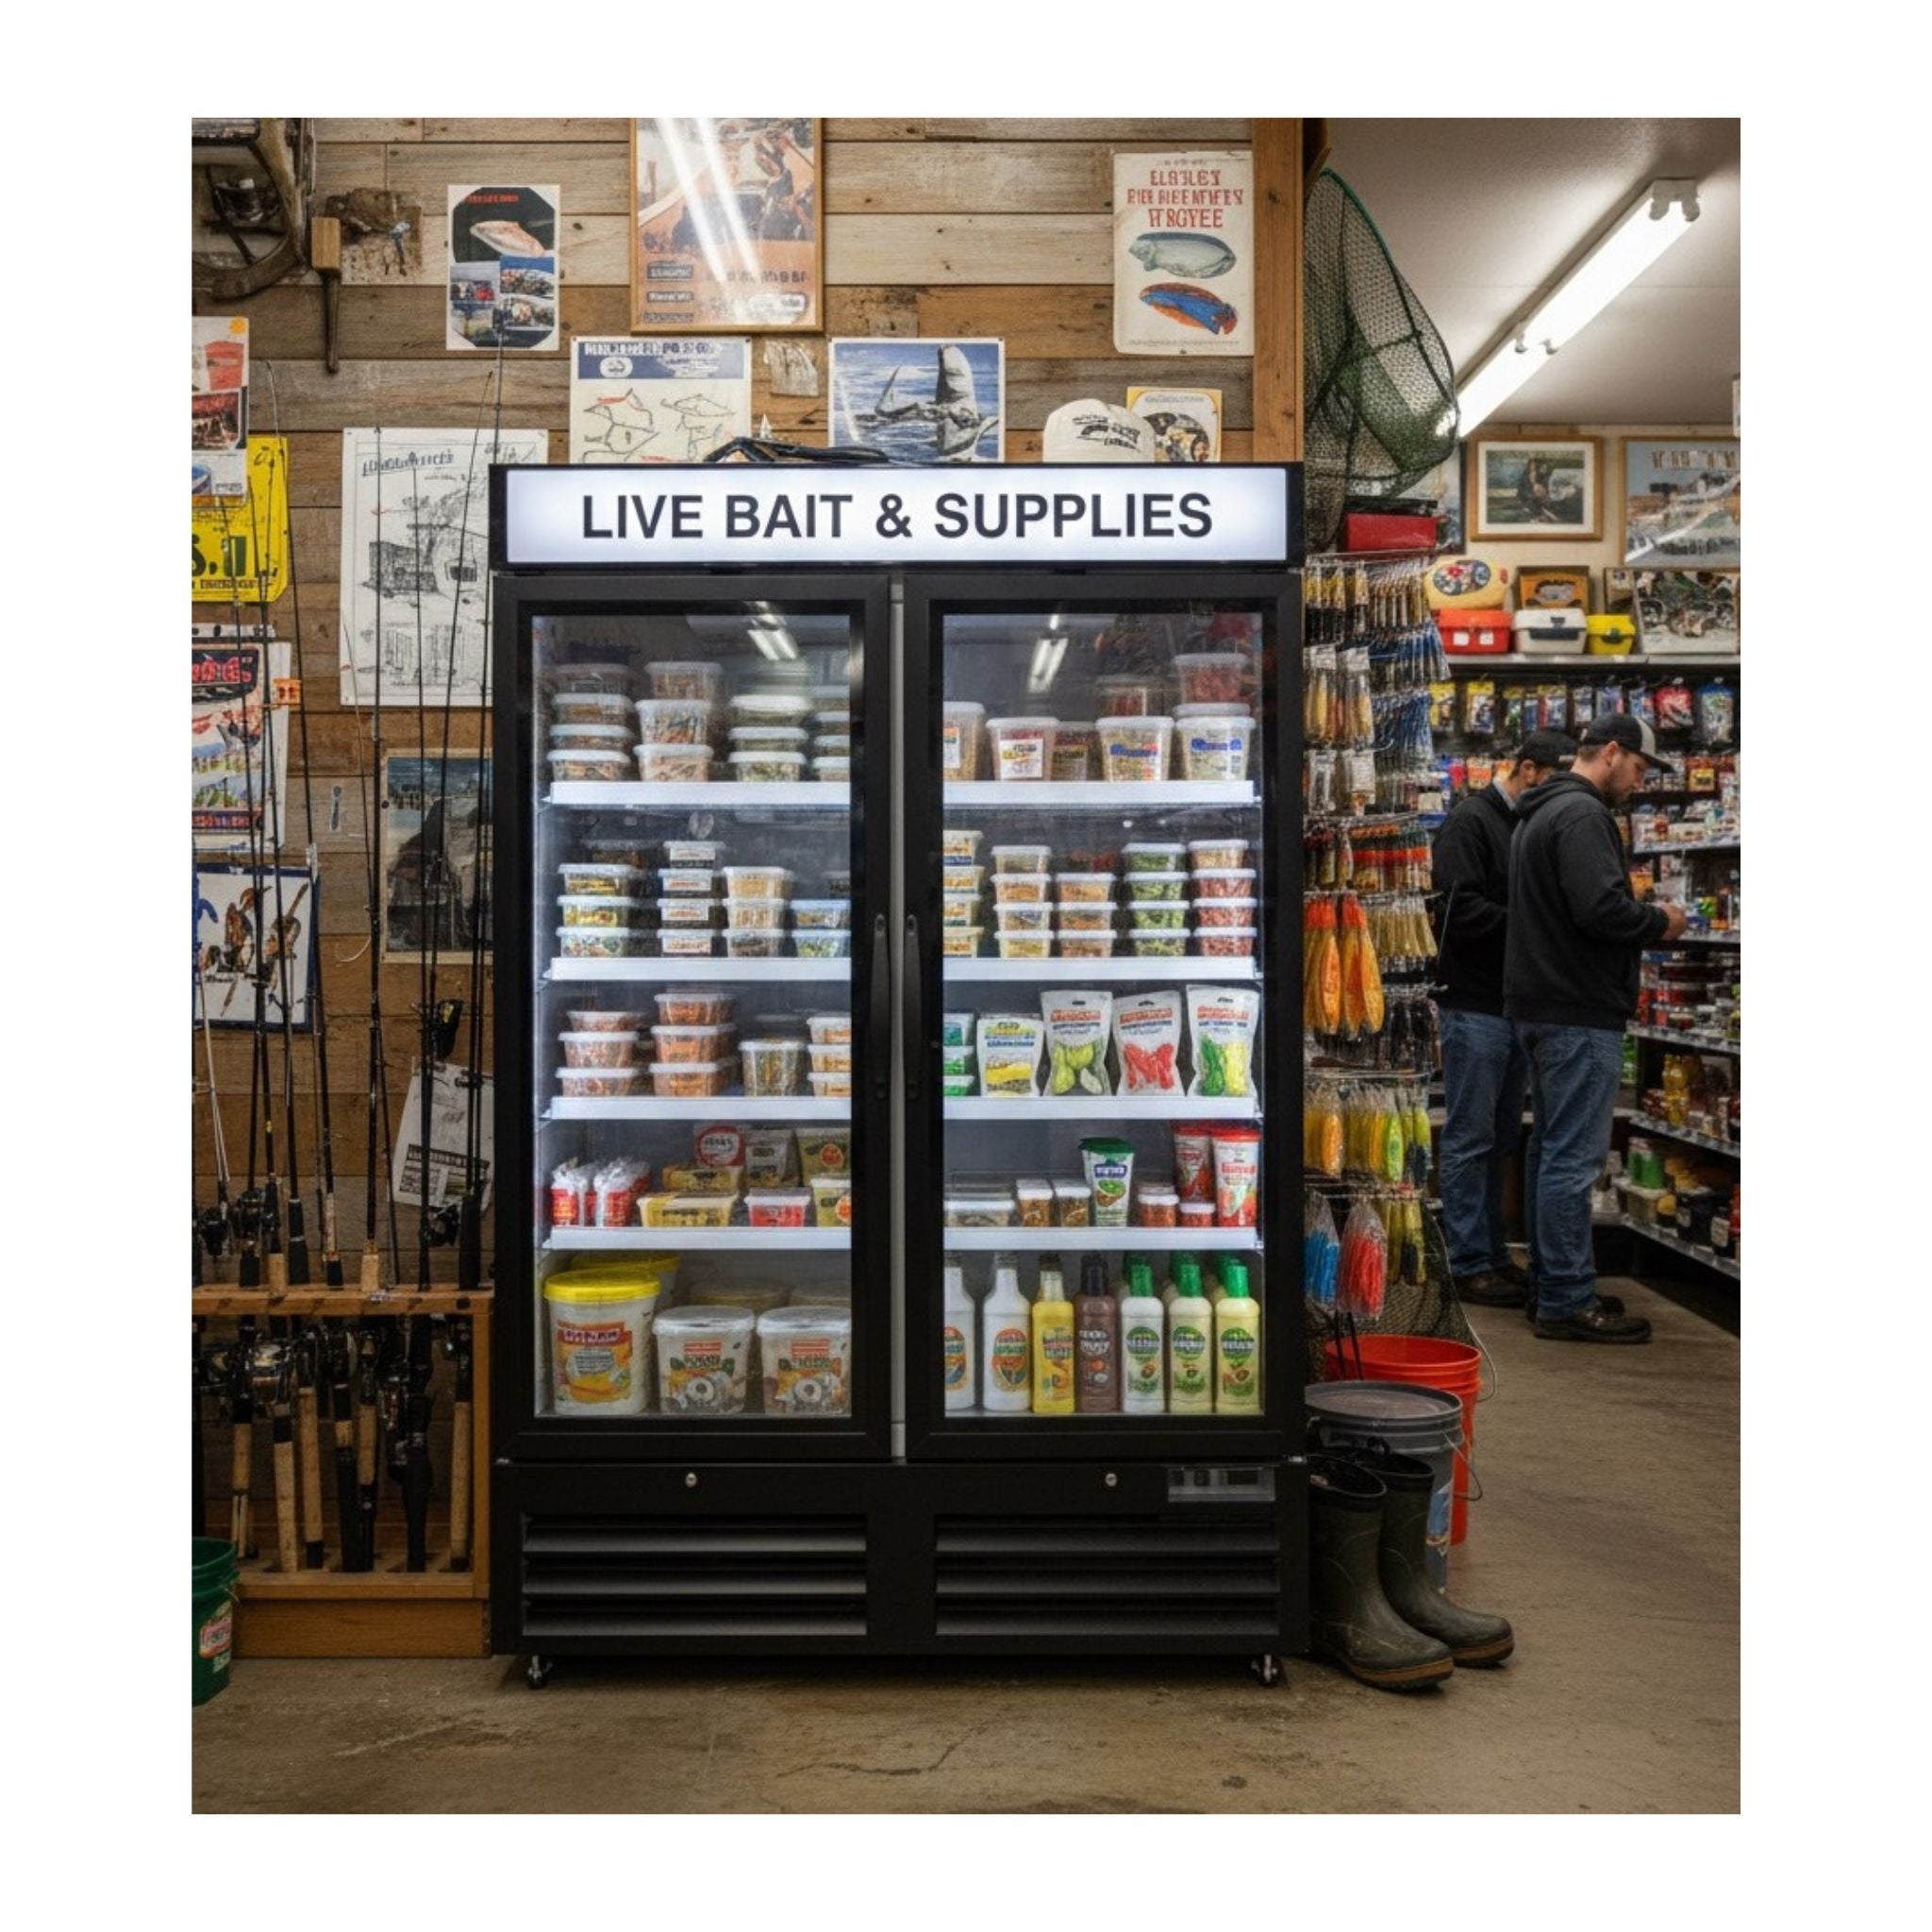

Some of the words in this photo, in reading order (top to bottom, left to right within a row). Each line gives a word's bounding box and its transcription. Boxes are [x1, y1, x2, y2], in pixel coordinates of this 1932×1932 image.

[583, 495, 702, 538] LIVE
[726, 494, 852, 537] BAIT
[875, 493, 911, 538] &
[935, 492, 1211, 538] SUPPLIES
